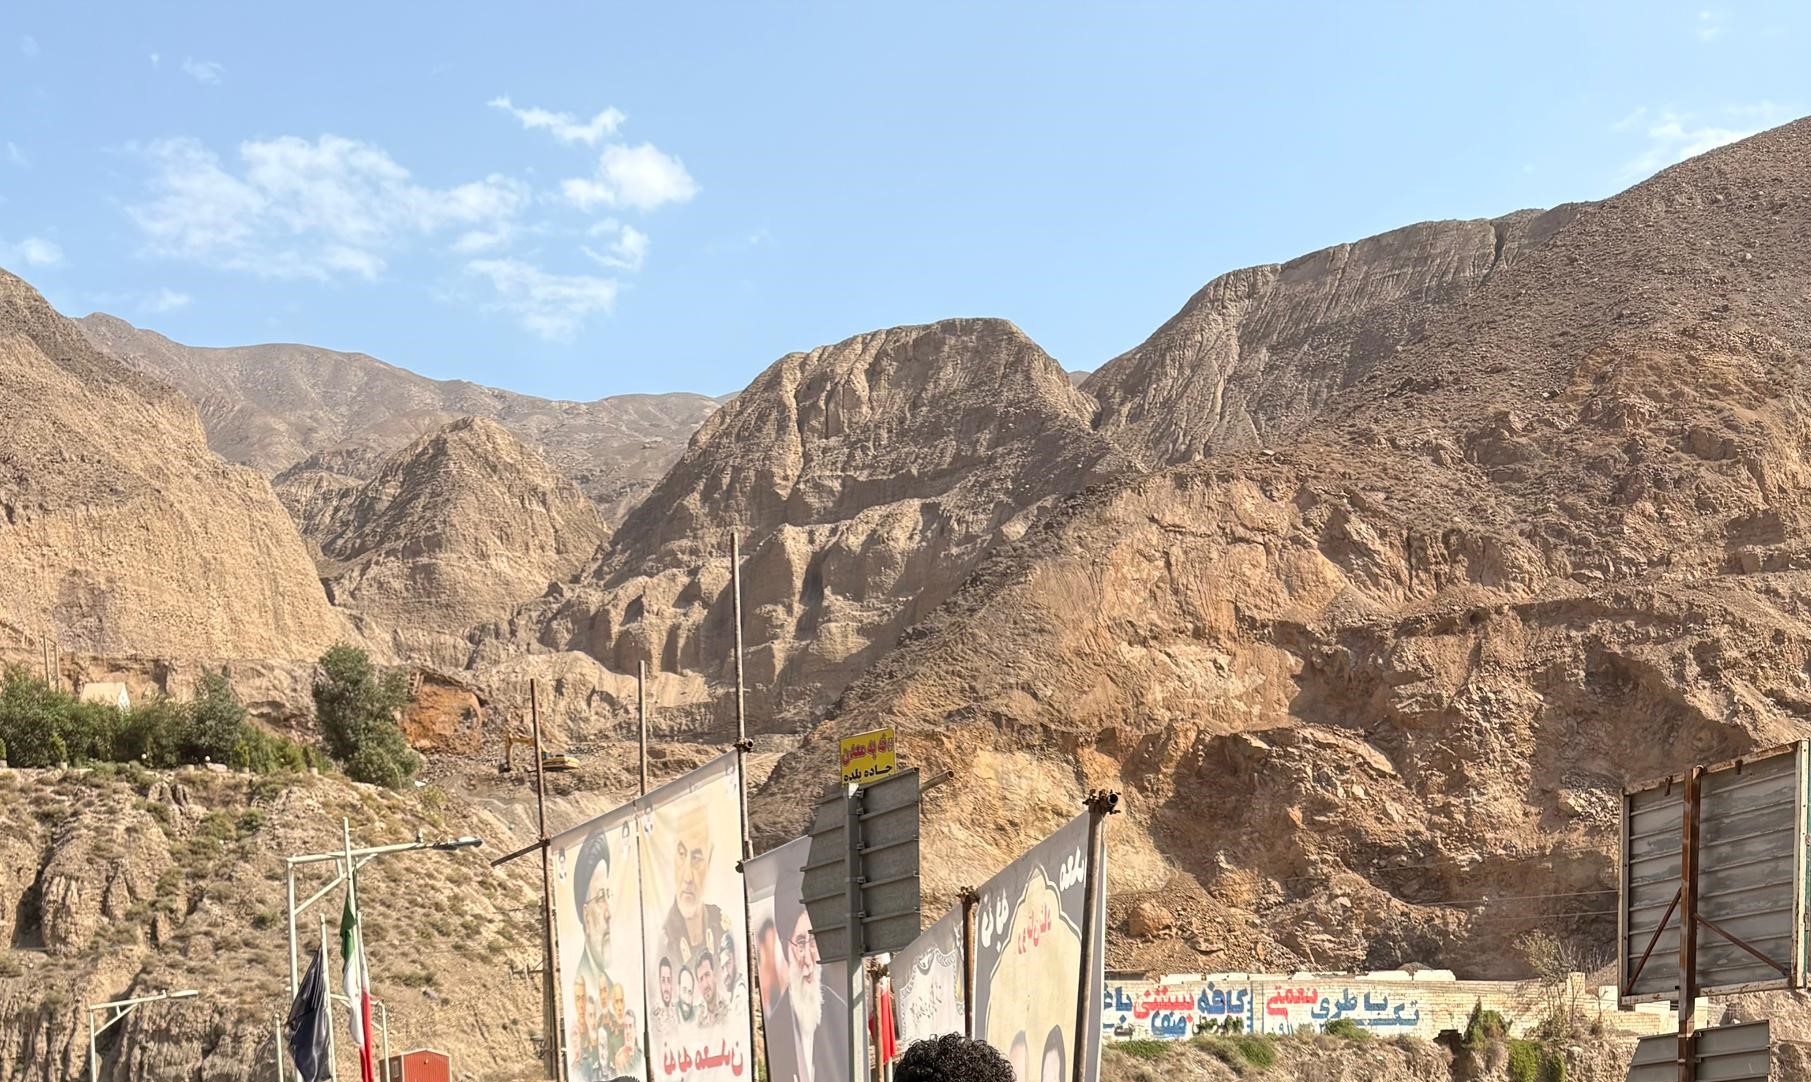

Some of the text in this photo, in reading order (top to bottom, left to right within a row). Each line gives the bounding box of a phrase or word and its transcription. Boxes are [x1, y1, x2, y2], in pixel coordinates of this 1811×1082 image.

[1133, 986, 1195, 1022] بستنی
[1197, 981, 1249, 1014] کافه
[1266, 985, 1318, 1021] نعمتی
